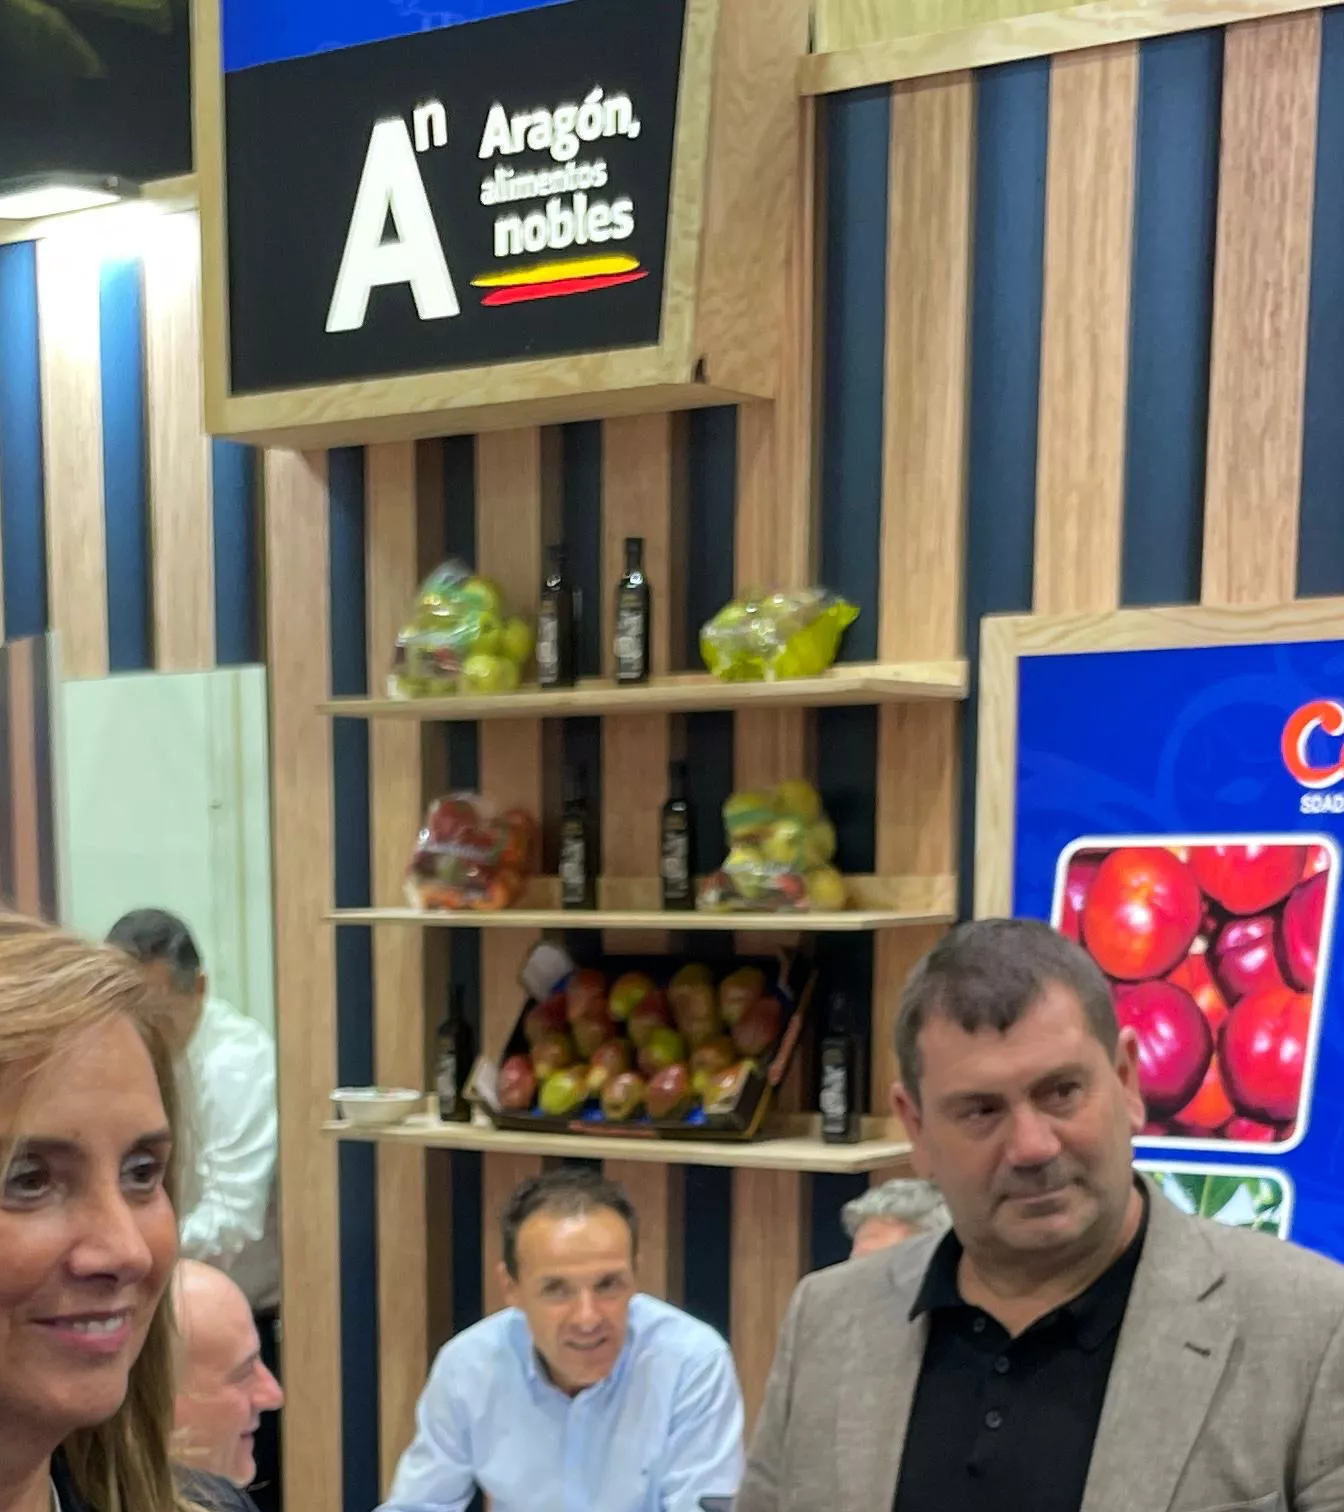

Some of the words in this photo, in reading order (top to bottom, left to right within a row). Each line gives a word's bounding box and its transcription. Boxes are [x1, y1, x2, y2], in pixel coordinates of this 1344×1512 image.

[478, 85, 642, 161] Aragón,
[480, 156, 608, 206] alimentos
[493, 192, 635, 257] nobles
